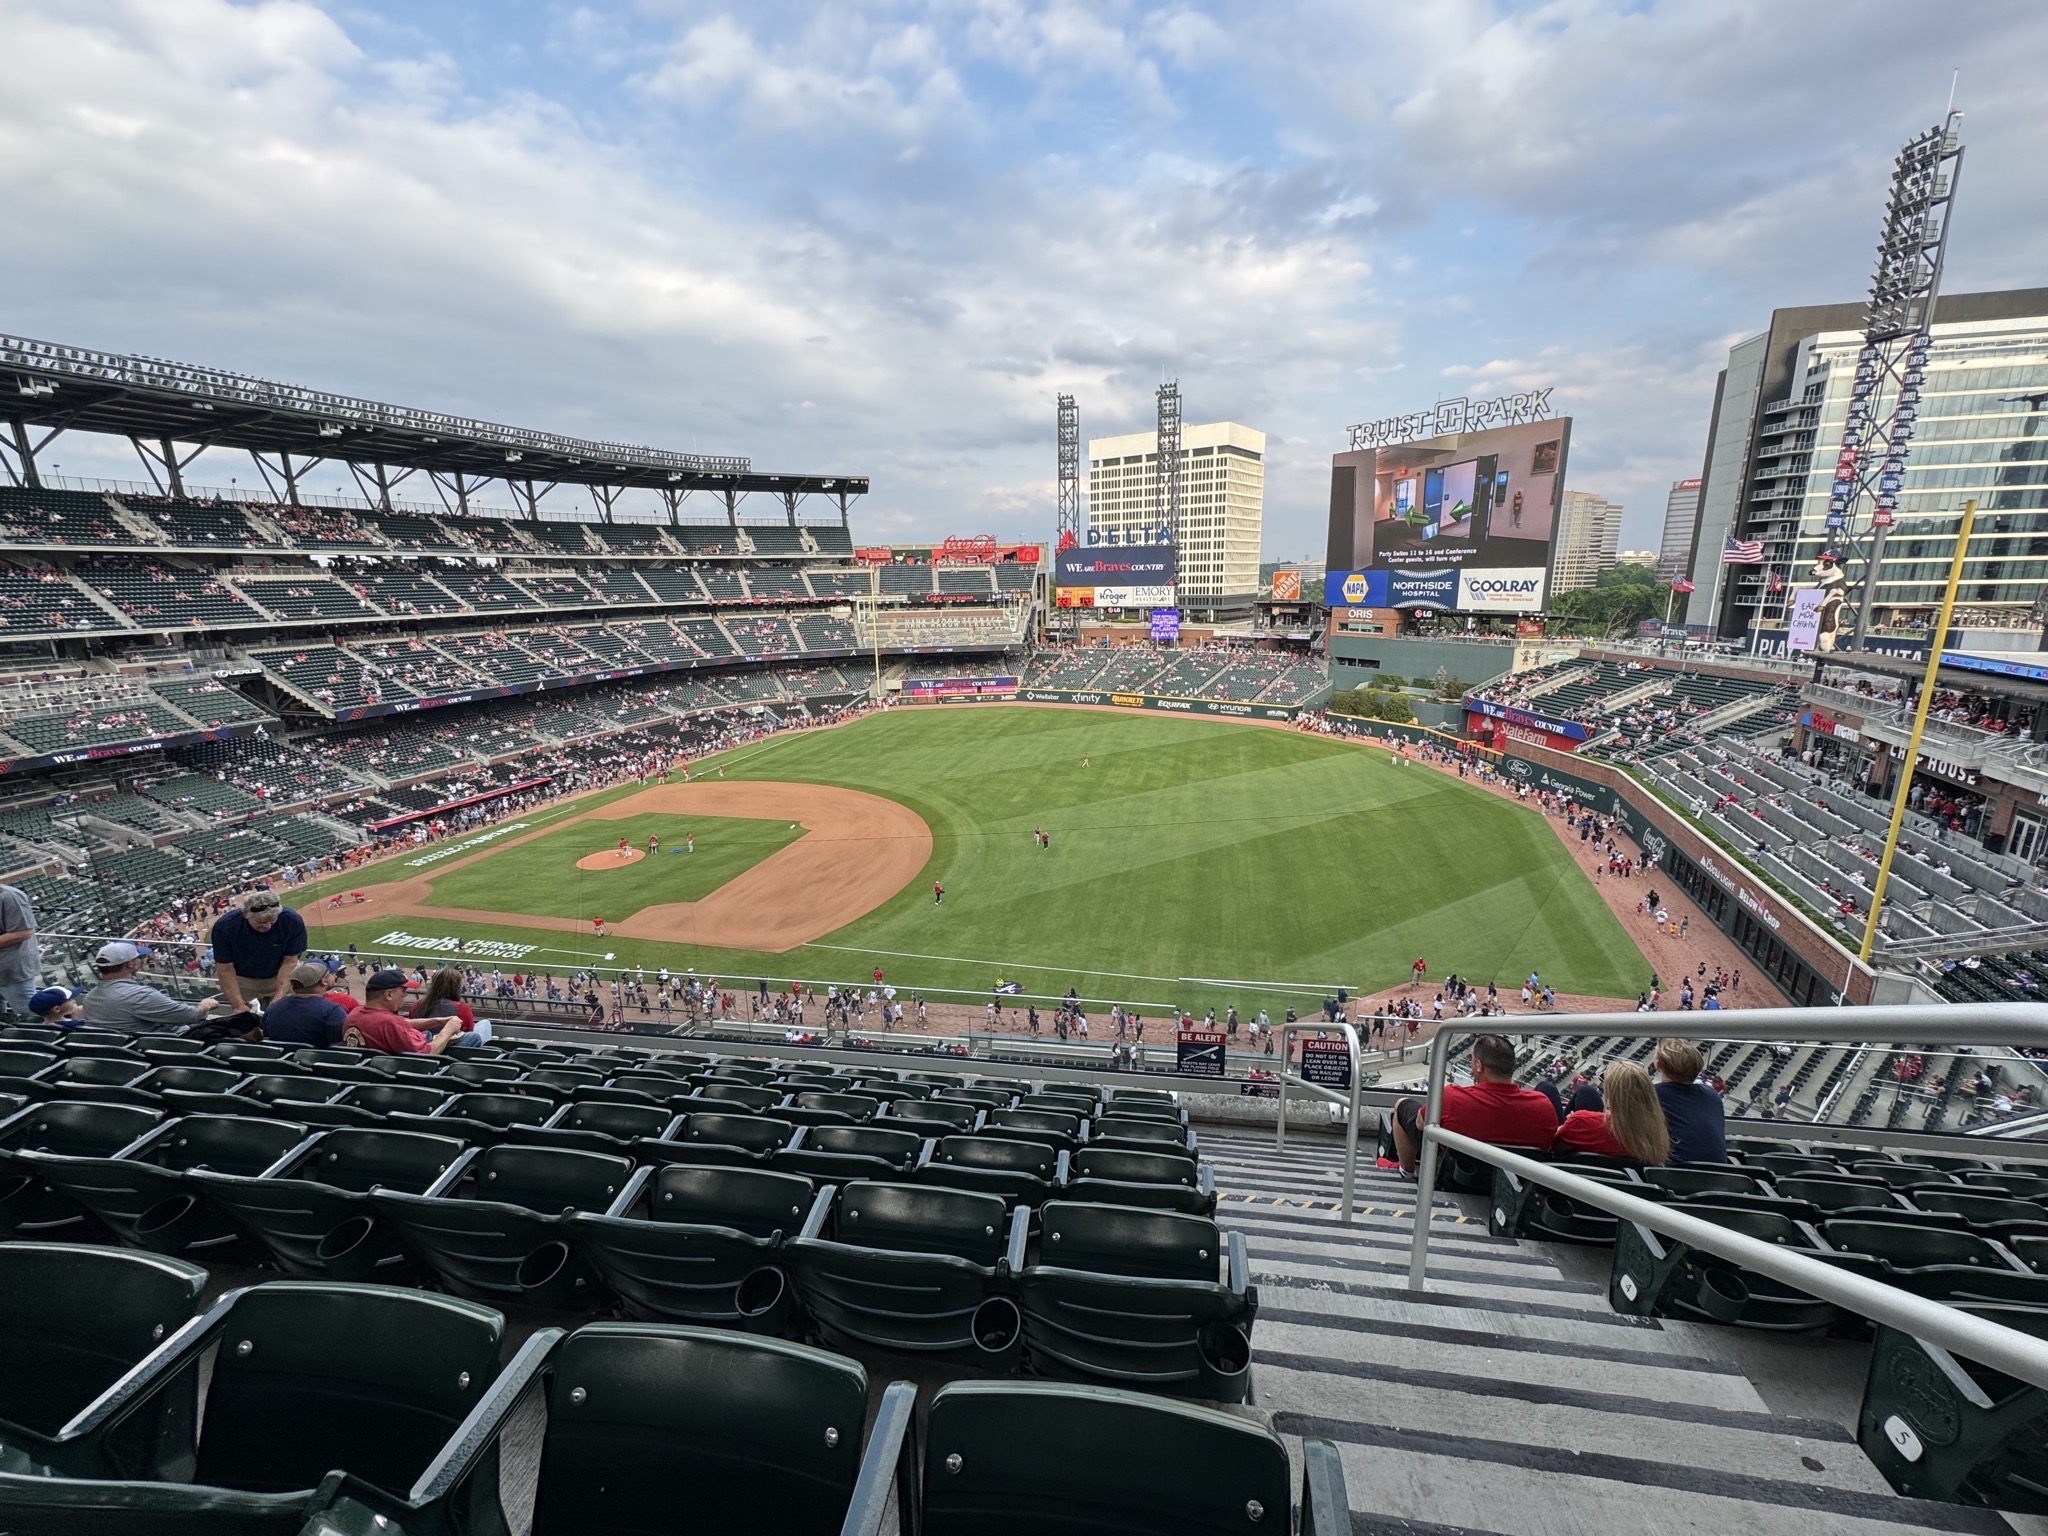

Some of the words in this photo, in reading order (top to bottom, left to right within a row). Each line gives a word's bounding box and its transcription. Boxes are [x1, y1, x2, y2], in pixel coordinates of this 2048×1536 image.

[1913, 336, 1928, 347] 1873
[1861, 350, 1875, 359] 1872
[1909, 355, 1924, 365] 1875
[1858, 367, 1872, 376] 1874
[1905, 374, 1920, 383] 1878
[1855, 384, 1868, 393] 1877
[1901, 391, 1916, 401] 1891
[1346, 411, 1430, 446] TRUIST
[1472, 387, 1554, 426] PARK
[1898, 409, 1913, 419] 1893
[1848, 419, 1862, 427] 1892
[1894, 427, 1909, 437] 1898
[1844, 435, 1859, 444] 1897
[1890, 445, 1905, 455] 1948
[1837, 469, 1852, 477] 1957
[1883, 480, 1898, 489] 1982
[1832, 501, 1844, 509] 1991
[1879, 498, 1894, 506] 1992
[1828, 517, 1842, 525] 1993
[1876, 514, 1890, 523] 1995
[1087, 526, 1173, 546] DELTA
[1066, 563, 1083, 573] WE
[1095, 561, 1131, 572] Braves
[1131, 563, 1166, 572] COUNTRY
[1346, 583, 1364, 595] NAPA
[1392, 581, 1453, 590] NORTHSIDE
[1469, 580, 1540, 593] COOLRAY
[1100, 588, 1127, 605] Kroger
[1135, 587, 1172, 596] EMORY
[1348, 610, 1373, 619] ORIS
[1423, 610, 1432, 618] LG
[1798, 611, 1815, 619] MOR
[1793, 620, 1818, 629] CHIKIN
[1661, 625, 1688, 636] Braves
[1759, 638, 1794, 661] PLAY
[944, 679, 972, 687] Braves
[394, 703, 410, 711] WE
[420, 698, 448, 707] Braves
[447, 696, 472, 704] COUNTRY
[1071, 693, 1101, 704] xfinity
[1112, 695, 1144, 704] QUIKRETE
[1157, 700, 1192, 709] EQUIFAX
[1482, 703, 1496, 715] WE
[1504, 707, 1535, 725] Braves
[1534, 720, 1566, 734] COUNTRY
[1834, 724, 1860, 742] LIGHT
[53, 754, 74, 763] WE
[88, 747, 128, 760] Braves
[128, 742, 163, 753] COUNTRY
[1510, 760, 1527, 774] Ford
[1890, 744, 1923, 765] CHP
[1927, 757, 1976, 785] HOUSE
[1550, 778, 1574, 794] Georgia
[1575, 787, 1596, 801] Power
[1705, 857, 1720, 879] Coors
[1720, 873, 1735, 891] LIGHT
[1739, 888, 1758, 911] BELOW
[1763, 909, 1780, 930] CHOP
[465, 939, 538, 953] CHEROKEE
[1181, 1033, 1193, 1041] BE
[1194, 1034, 1222, 1042] ALERT
[1308, 1041, 1348, 1051] CAUTION
[1625, 1284, 1632, 1293] 4
[1895, 1431, 1911, 1445] 5
